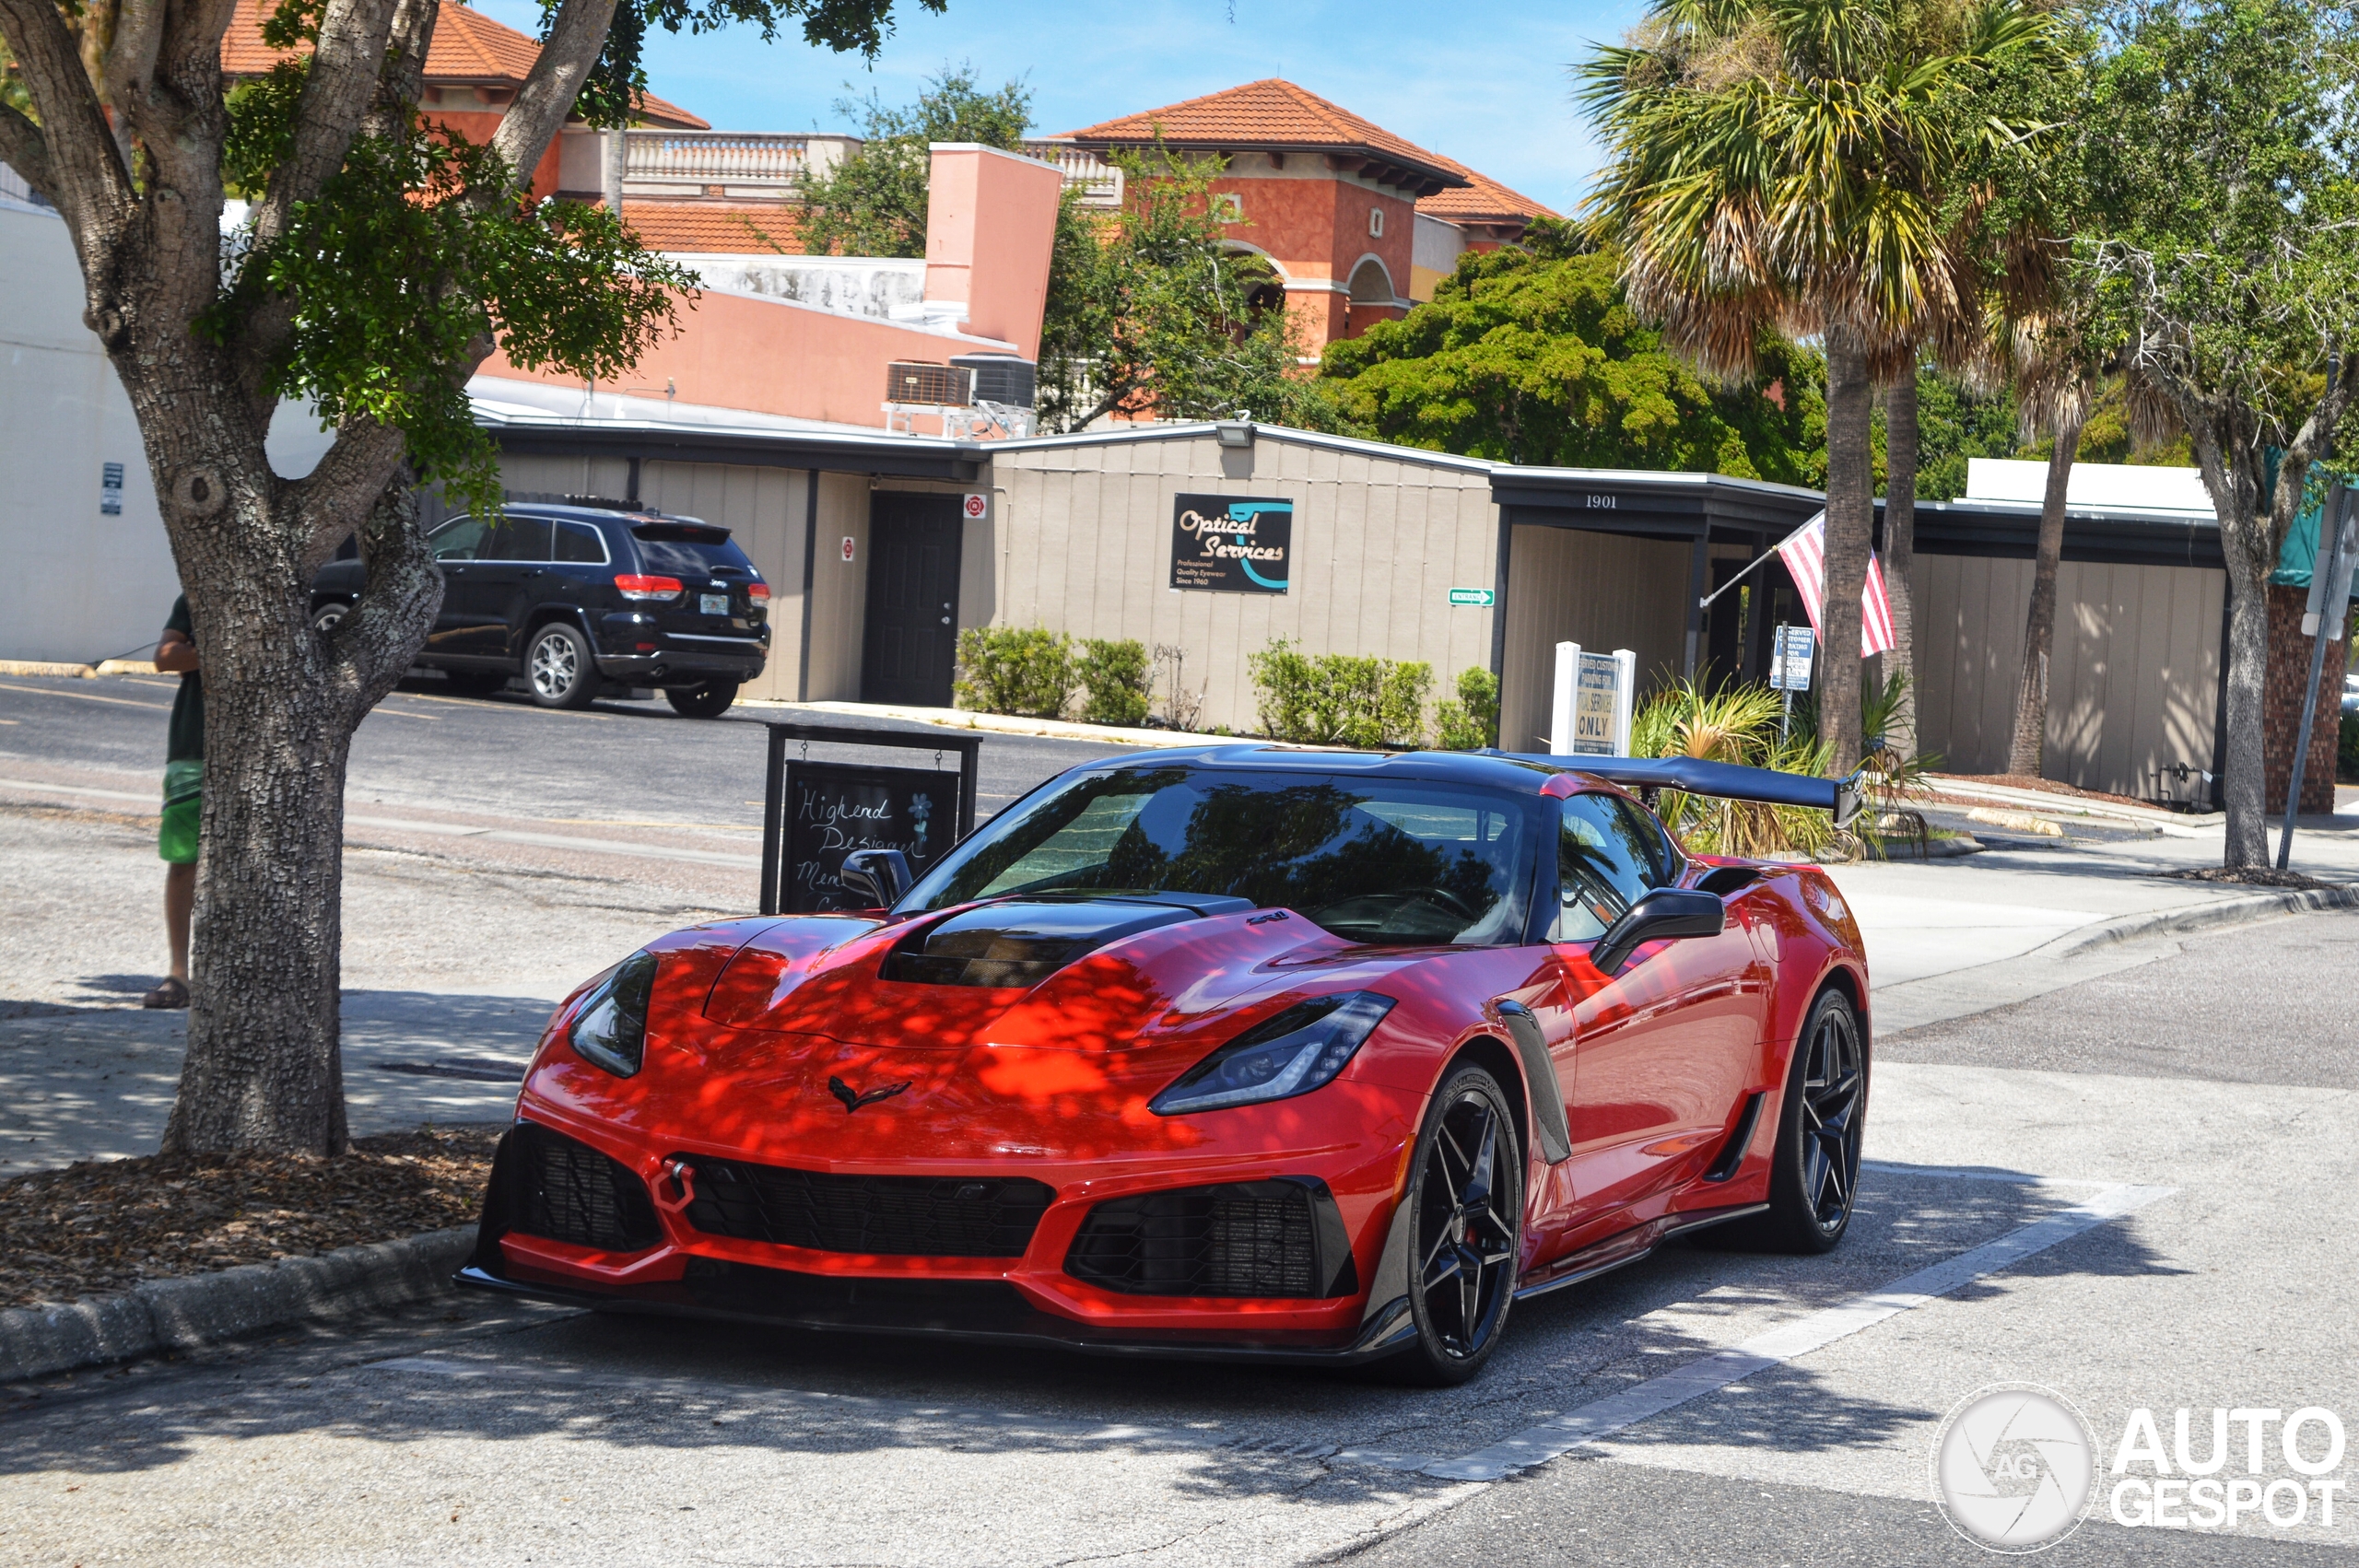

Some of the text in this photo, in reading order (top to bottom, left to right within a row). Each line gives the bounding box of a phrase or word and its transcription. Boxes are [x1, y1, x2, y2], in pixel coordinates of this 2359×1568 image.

[1586, 495, 1616, 509] 1901
[1180, 509, 1260, 541] Optical
[1200, 535, 1284, 561] Services
[1177, 559, 1214, 568] Professional
[1176, 568, 1226, 578] Quality Eyewear
[1176, 577, 1192, 585] Since
[1579, 715, 1608, 736] ONLY
